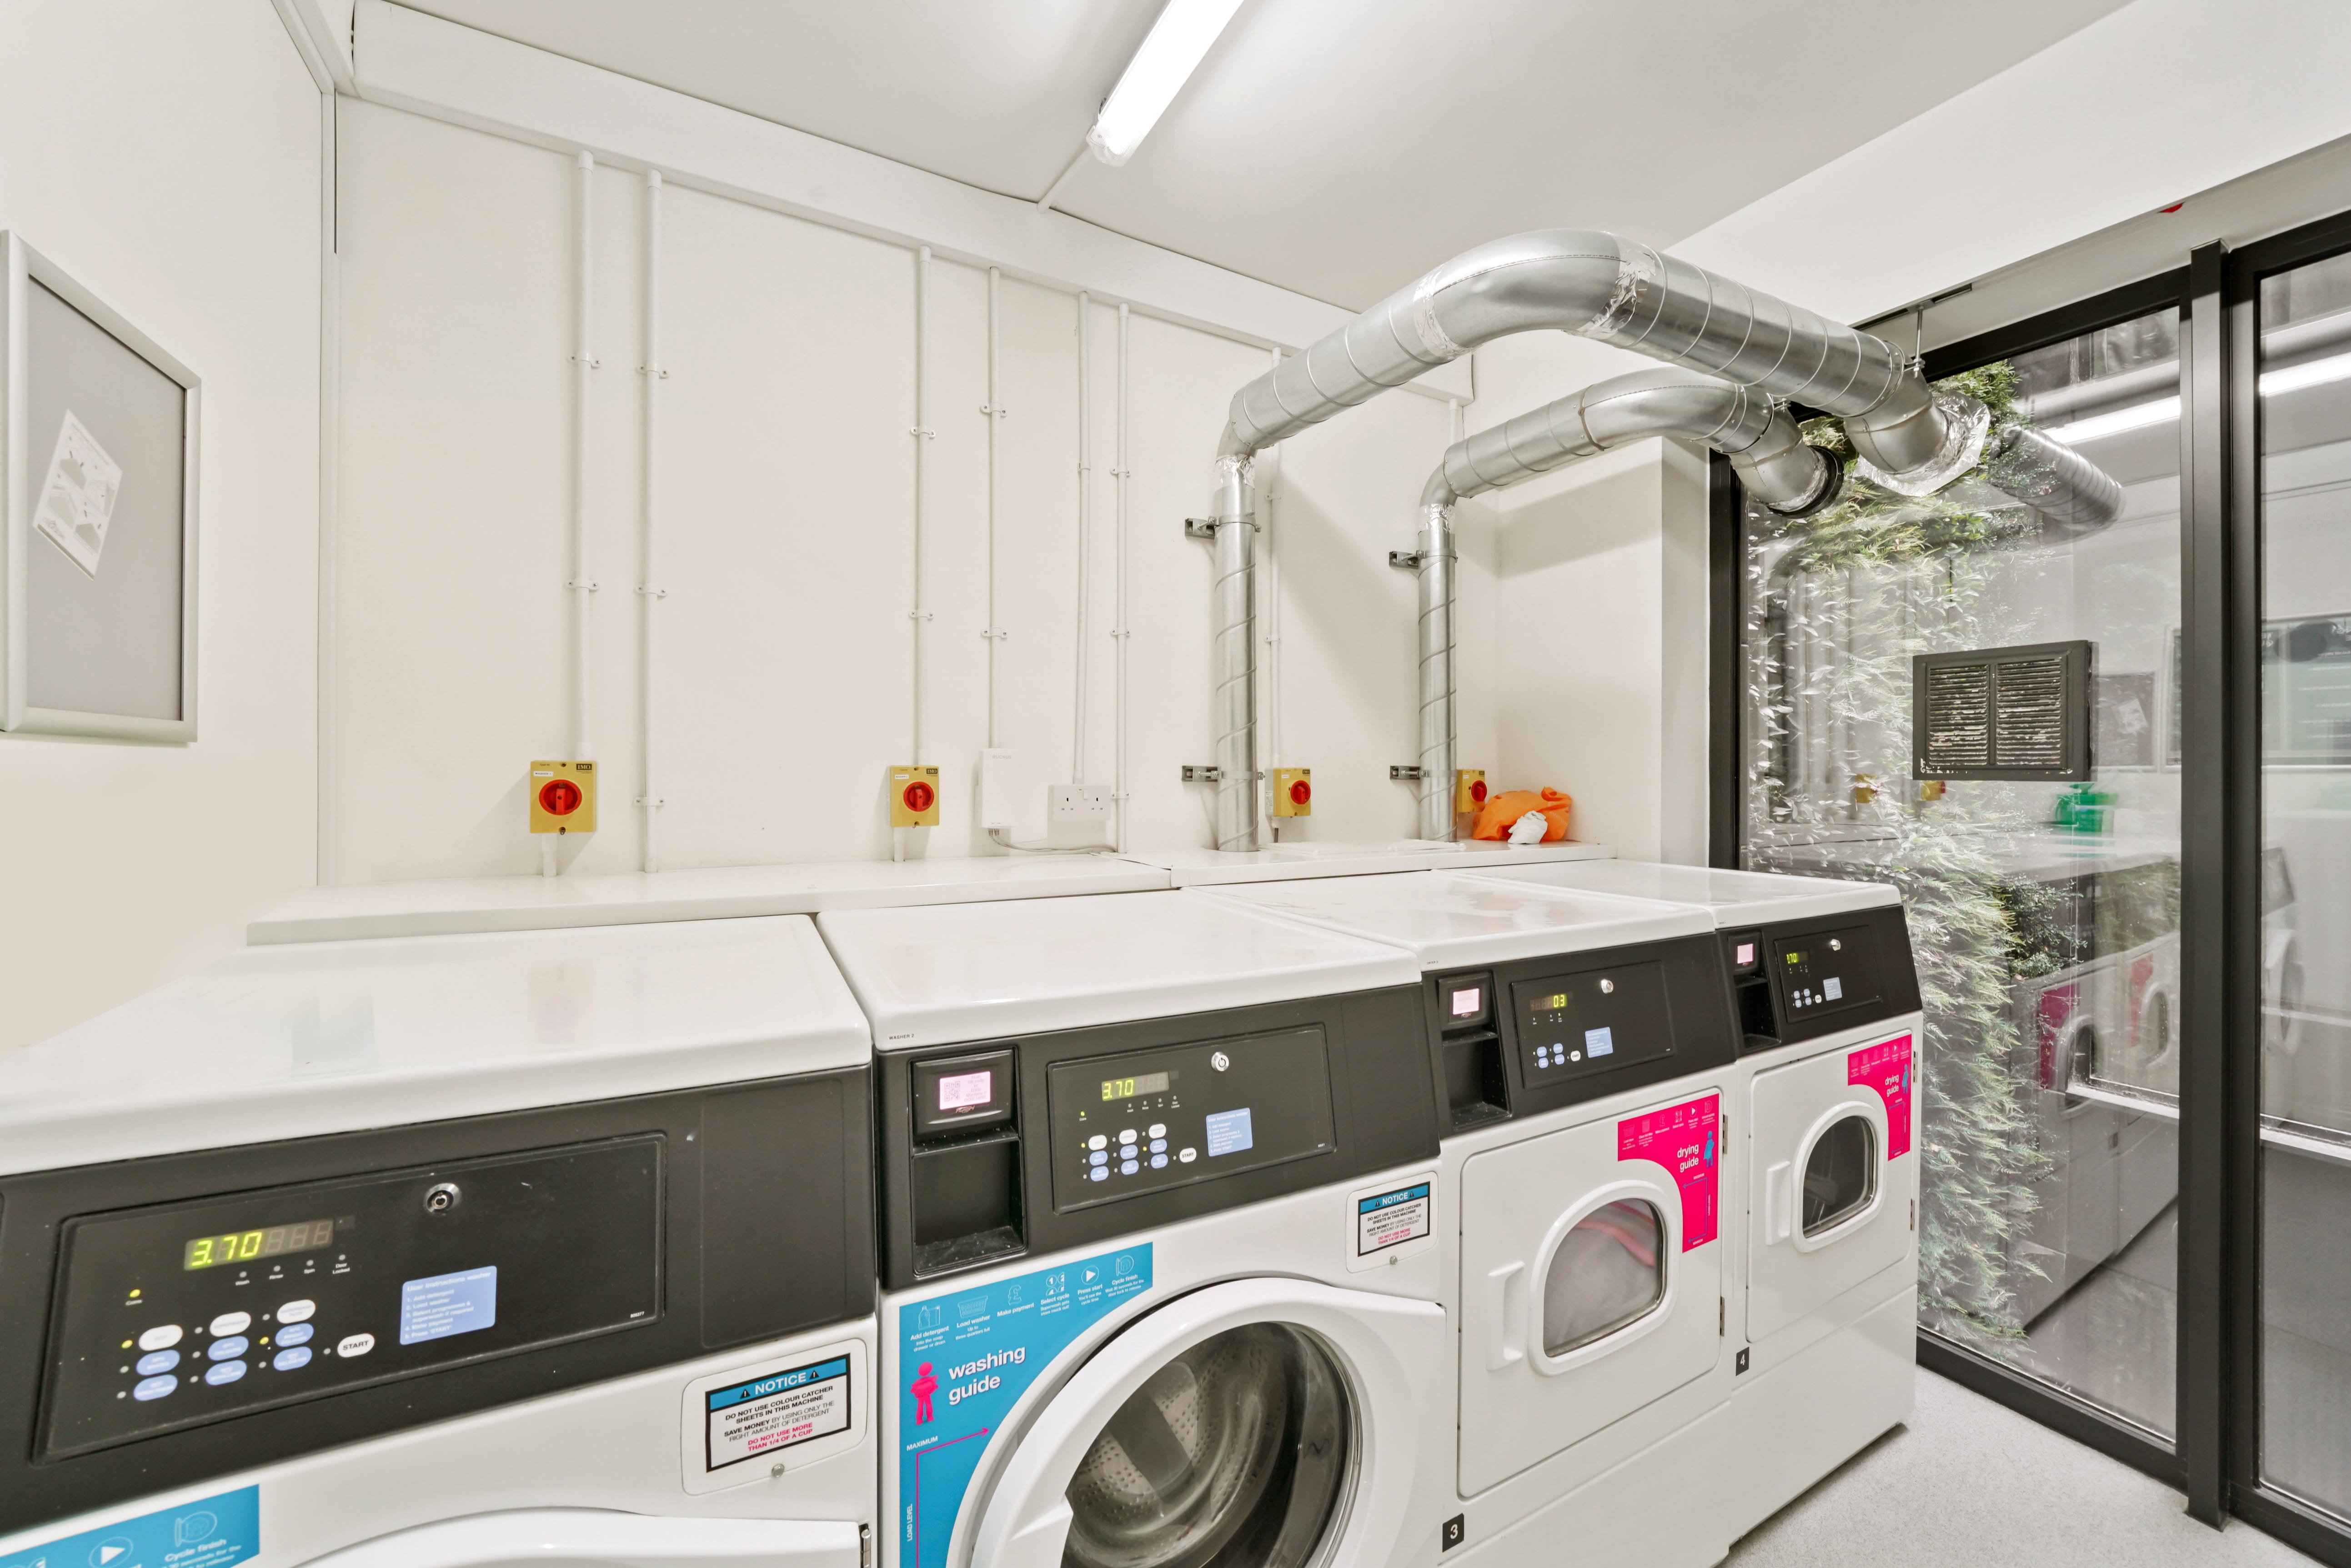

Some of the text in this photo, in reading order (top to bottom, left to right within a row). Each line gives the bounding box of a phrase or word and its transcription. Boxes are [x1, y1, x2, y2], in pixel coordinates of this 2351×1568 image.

[1554, 994, 1564, 1007] 03
[1885, 1075, 1899, 1085] drying
[1103, 1079, 1133, 1099] 3.70
[1887, 1085, 1899, 1097] guide
[1677, 1144, 1699, 1158] drying
[1680, 1156, 1699, 1172] guide
[1382, 1192, 1408, 1205] NOTICE
[1400, 1219, 1419, 1227] DETERGENT
[191, 1231, 263, 1267] 3.70
[1112, 1277, 1124, 1286] Cycle
[1041, 1297, 1055, 1305] Select
[997, 1302, 1034, 1317] Make payment
[957, 1314, 990, 1328] Load washer
[923, 1326, 949, 1338] detergent
[342, 1341, 369, 1350] START
[948, 1347, 1025, 1380] washing
[1740, 1354, 1745, 1366] 4
[755, 1372, 806, 1395] NOTICE
[949, 1375, 1001, 1405] guide
[738, 1408, 752, 1417] NOT
[755, 1403, 768, 1412] USE
[771, 1395, 799, 1407] COLOUR
[802, 1385, 832, 1398] CATCHER
[736, 1412, 763, 1423] SHEETS
[774, 1404, 789, 1413] THIS
[792, 1395, 822, 1408] MACHINE
[724, 1427, 742, 1437] SAVE
[744, 1419, 770, 1431] MONEY
[782, 1410, 802, 1420] USING
[804, 1404, 820, 1413] ONLY
[729, 1432, 749, 1442] RIGHT
[751, 1423, 779, 1435] AMOUNT
[792, 1408, 829, 1423] DETERGENT
[760, 1433, 774, 1442] NOT
[777, 1429, 790, 1437] USE
[792, 1422, 812, 1432] MORE
[748, 1442, 767, 1452] THAN
[798, 1428, 812, 1437] CUP
[907, 1436, 938, 1451] MAXIMUM
[1450, 1524, 1459, 1539] 3
[165, 1548, 195, 1562] Cycle
